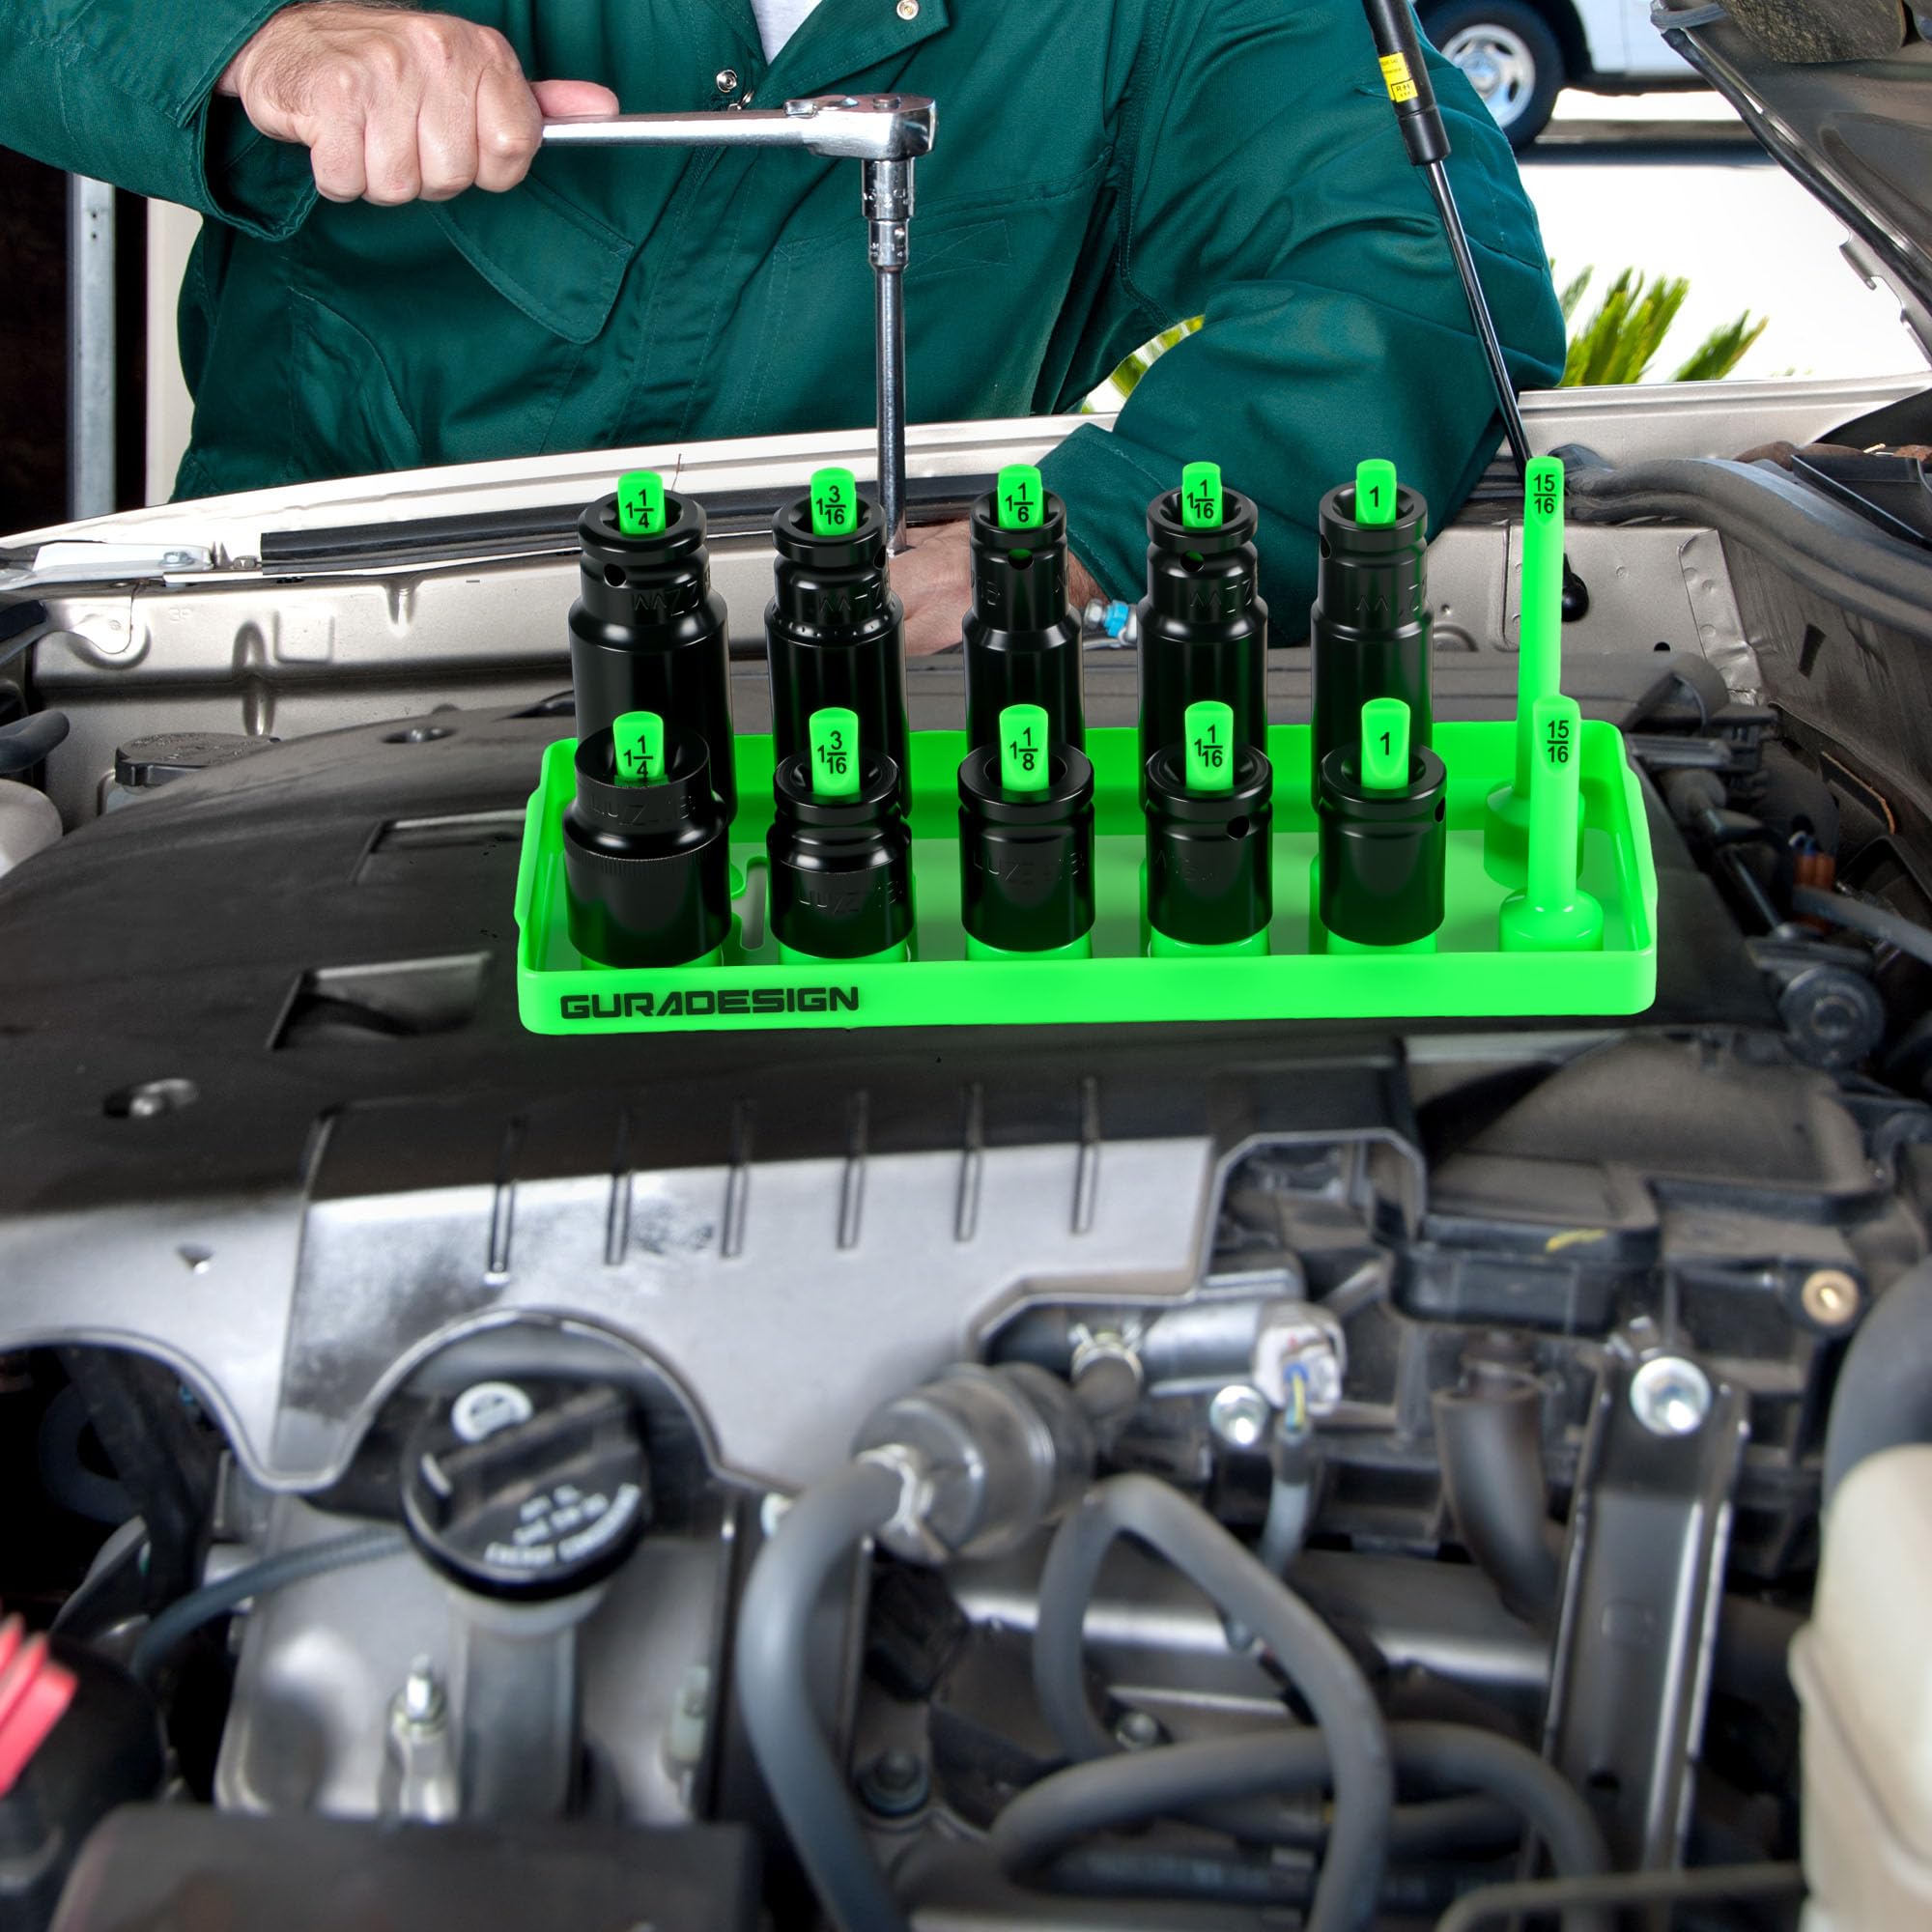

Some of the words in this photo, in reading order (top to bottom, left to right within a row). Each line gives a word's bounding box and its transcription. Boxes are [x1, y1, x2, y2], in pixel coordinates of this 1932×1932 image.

[1370, 486, 1378, 507] 1
[1379, 731, 1390, 755] 1
[561, 986, 860, 1020] GURADESIGN
